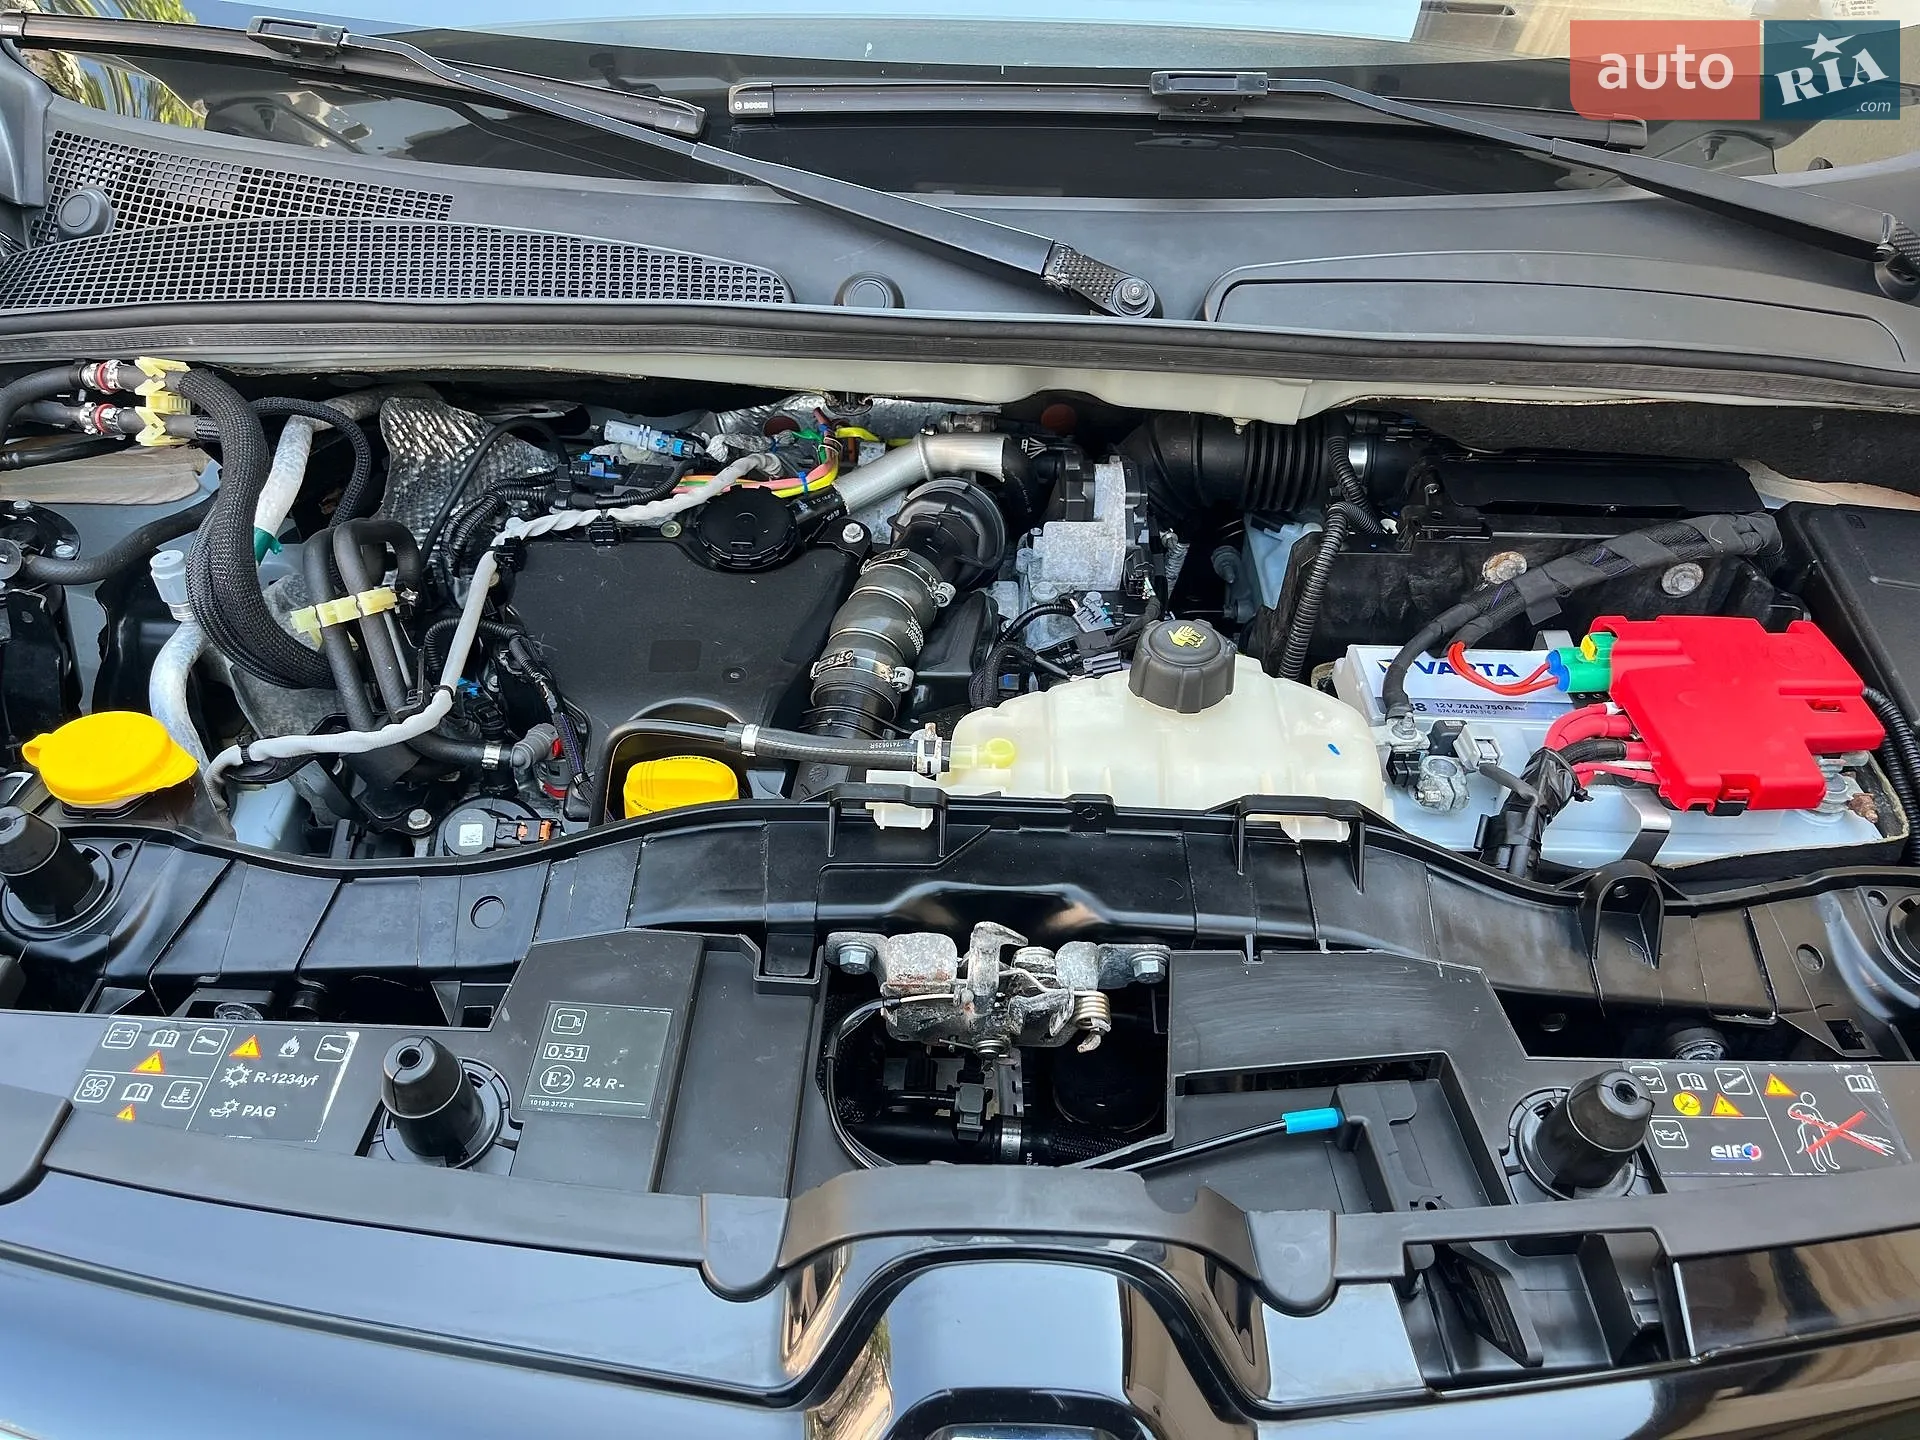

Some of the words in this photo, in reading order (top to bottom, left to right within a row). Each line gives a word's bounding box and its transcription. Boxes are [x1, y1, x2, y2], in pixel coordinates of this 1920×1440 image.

[1413, 661, 1520, 677] VATA
[547, 1046, 584, 1060] 0,51
[253, 1071, 320, 1088] R-1234yf
[583, 1076, 600, 1089] 24
[241, 1104, 277, 1118] PAG
